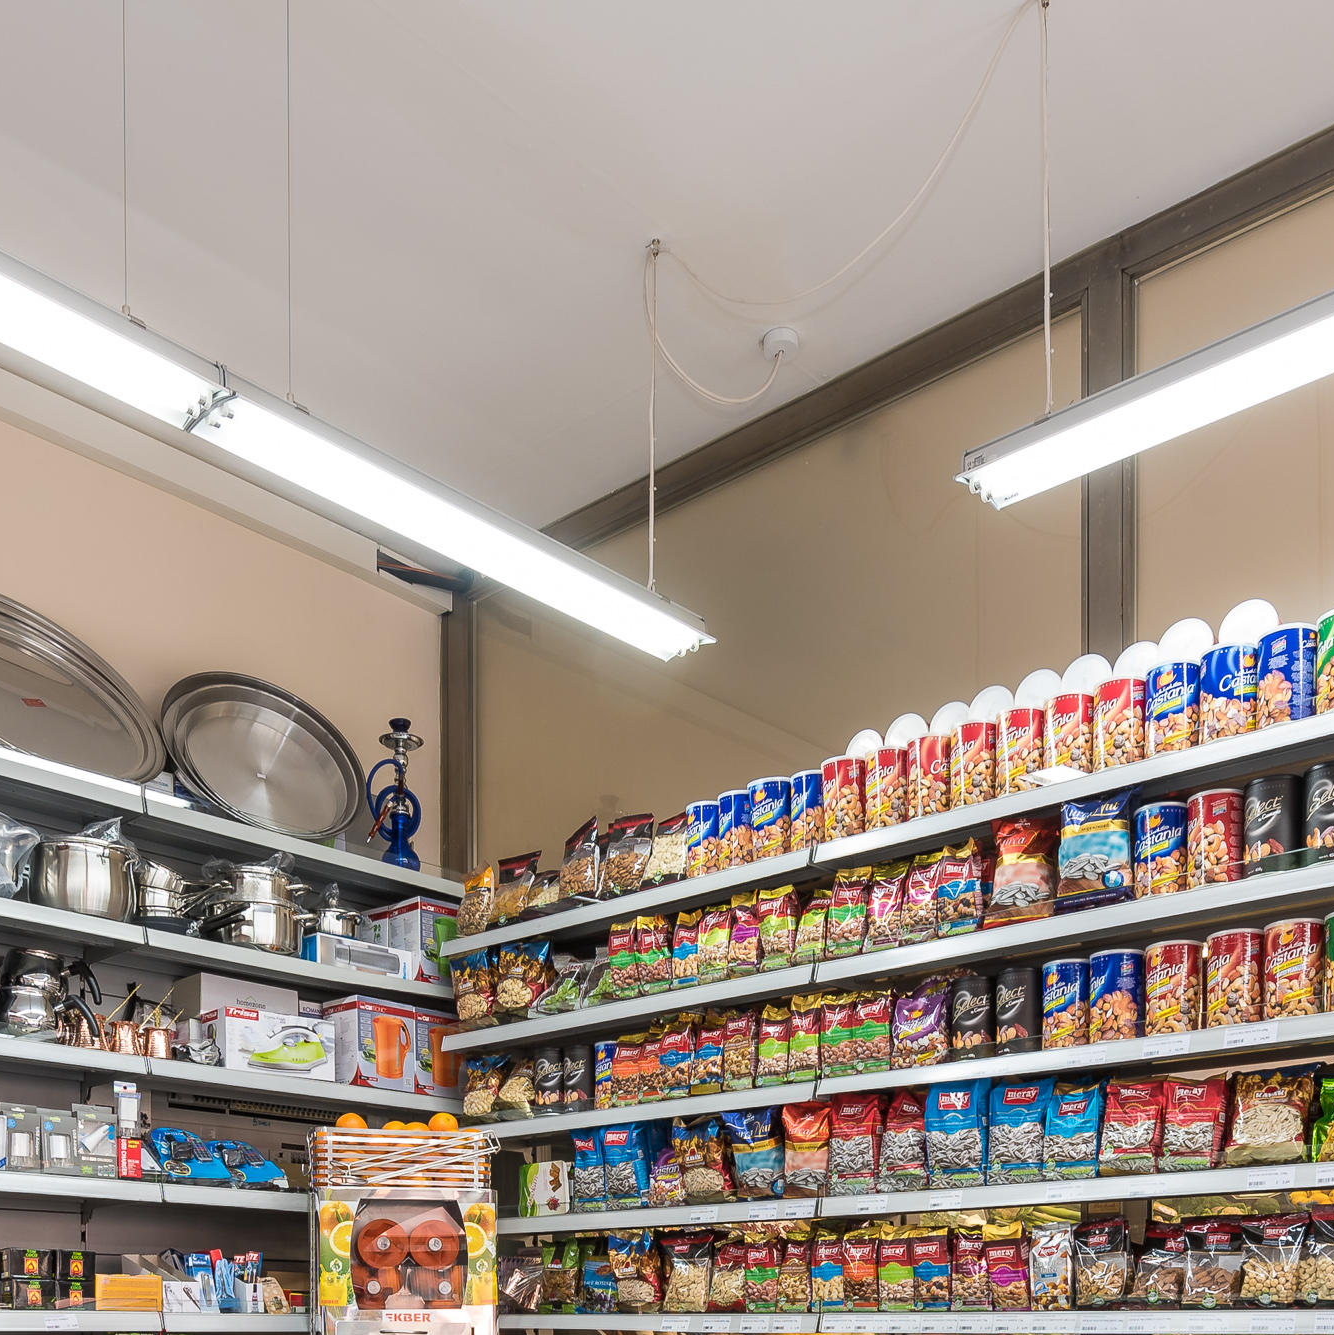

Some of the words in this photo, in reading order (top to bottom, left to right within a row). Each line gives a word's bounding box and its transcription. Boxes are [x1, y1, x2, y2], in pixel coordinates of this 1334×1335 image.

[226, 1007, 258, 1020] Trisa
[1007, 1088, 1037, 1101] meray
[1061, 1101, 1086, 1115] meray
[1266, 1228, 1287, 1237] meray
[1208, 1235, 1230, 1244] meray
[882, 1246, 907, 1258] meray
[989, 1249, 1015, 1259] meray
